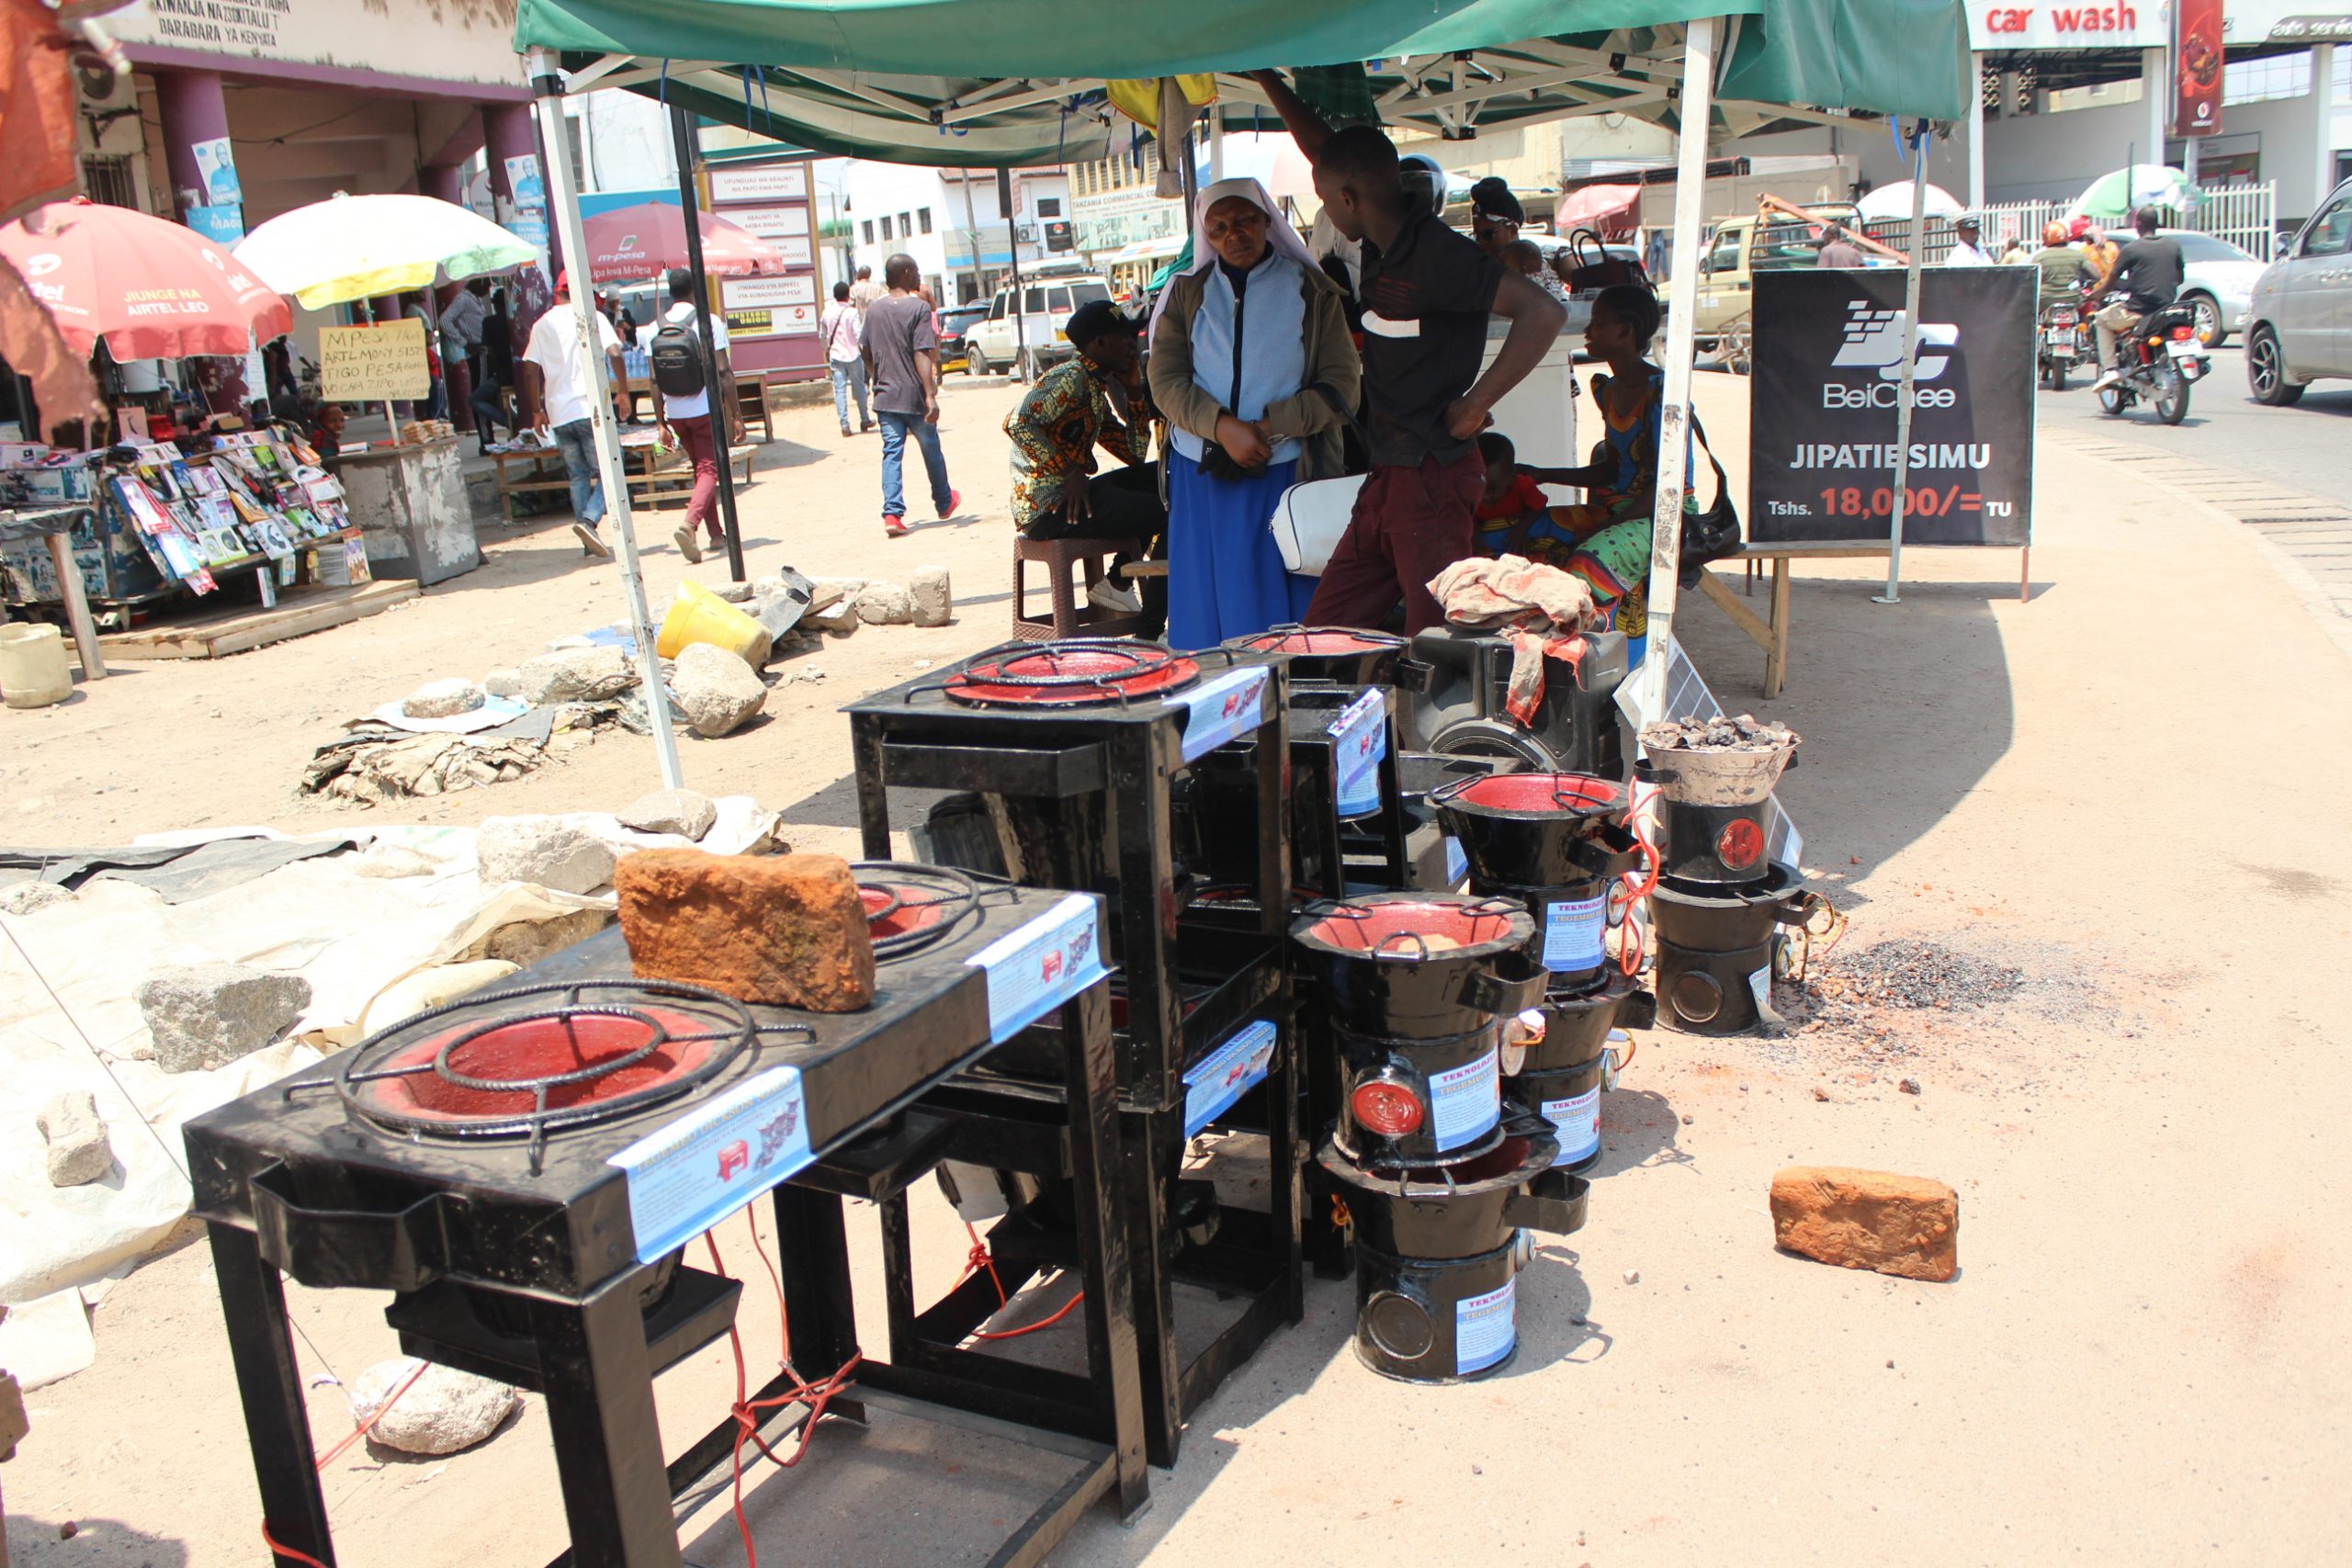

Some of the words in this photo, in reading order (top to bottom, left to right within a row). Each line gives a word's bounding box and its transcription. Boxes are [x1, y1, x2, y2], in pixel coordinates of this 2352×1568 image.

[1986, 7, 2033, 33] car
[2052, 0, 2137, 32] wash
[158, 17, 221, 42] BARABARA
[224, 28, 239, 43] YA
[241, 30, 277, 48] KENYATA
[1073, 197, 1102, 209] TANZANIA
[1103, 193, 1145, 205] COMMERCIAL
[597, 251, 647, 263] m-pesa
[623, 265, 651, 275] M-Pesa
[123, 288, 177, 302] JIUNGE
[180, 288, 203, 300] NA
[127, 302, 179, 316] AIRTEL
[180, 301, 209, 314] LEO
[727, 310, 767, 320] WESTERN
[740, 317, 768, 325] UNION
[324, 367, 360, 380] TIGO
[366, 362, 402, 378] PESA
[1908, 444, 1991, 469] SIMU
[1769, 501, 1813, 515] Tshs.
[1986, 502, 2012, 517] TU
